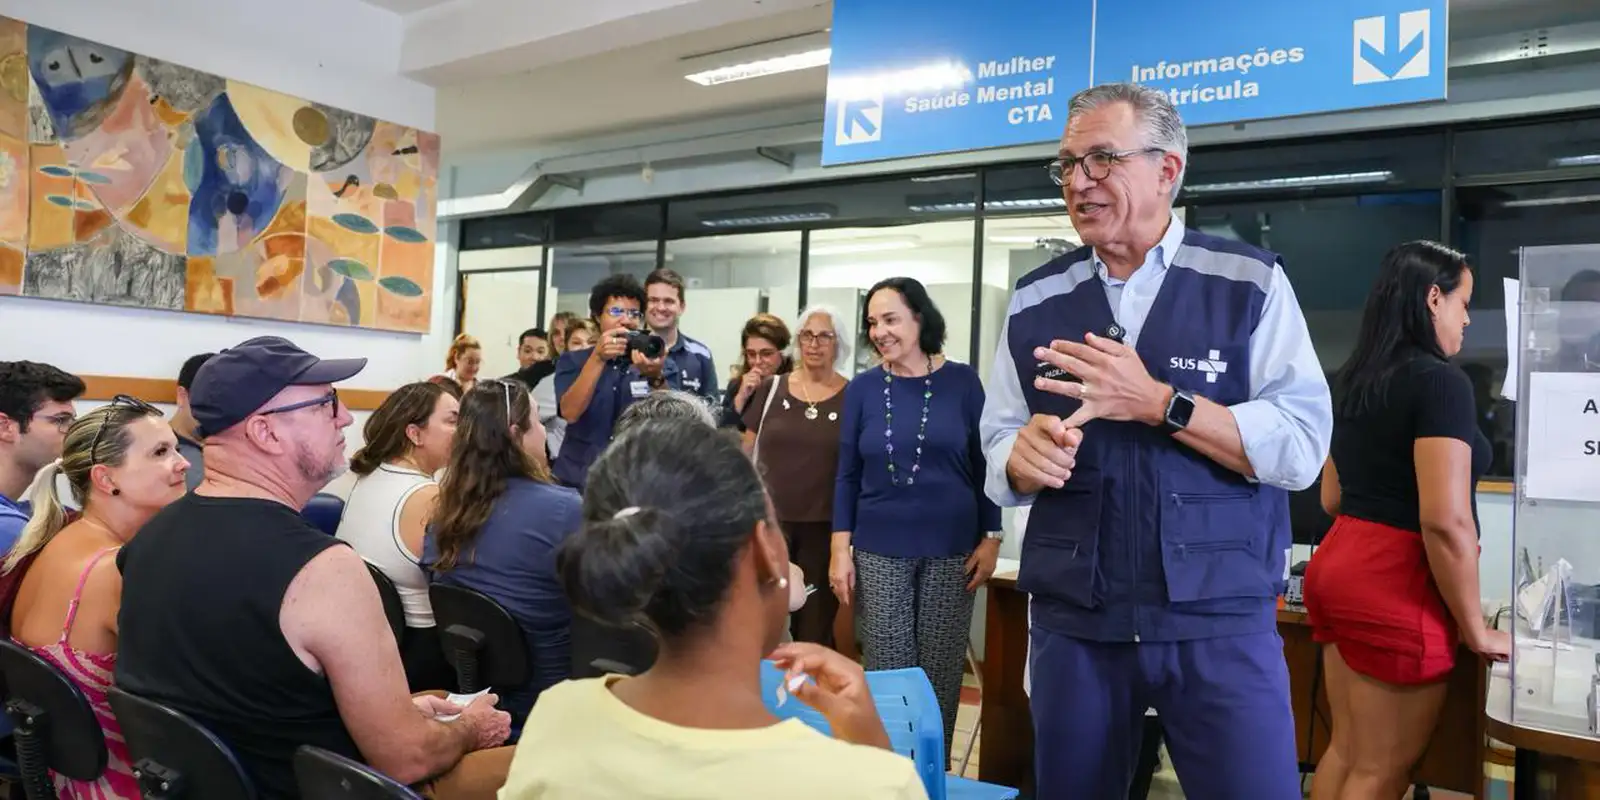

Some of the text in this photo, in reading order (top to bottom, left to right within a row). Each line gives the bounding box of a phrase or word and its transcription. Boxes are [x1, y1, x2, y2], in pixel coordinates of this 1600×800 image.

[978, 55, 1056, 79] Mulher
[1131, 46, 1305, 83] Informações
[904, 77, 1055, 113] Saúde Mental
[1138, 79, 1260, 107] atrícula
[1007, 103, 1053, 125] CTA
[1169, 356, 1197, 370] SUS
